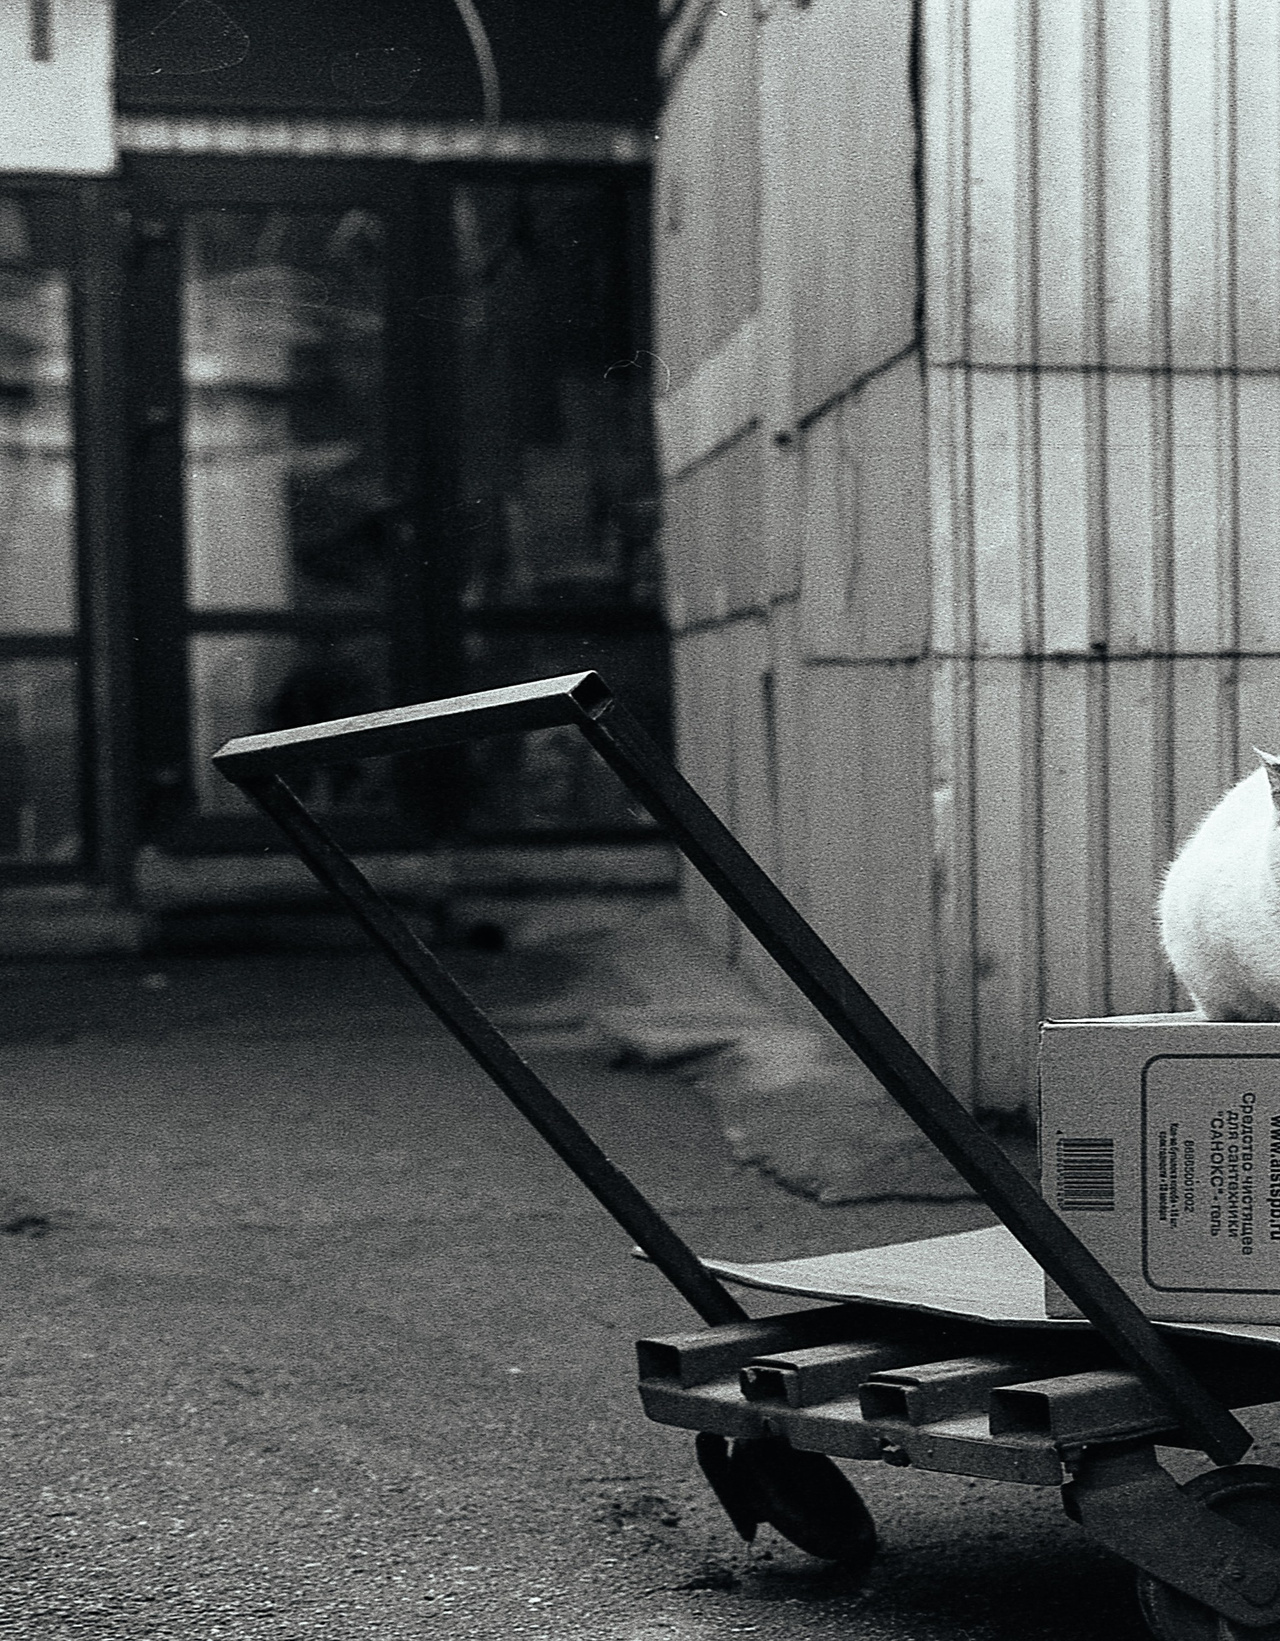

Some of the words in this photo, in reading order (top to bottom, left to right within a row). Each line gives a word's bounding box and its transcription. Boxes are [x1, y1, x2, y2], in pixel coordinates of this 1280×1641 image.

[1210, 1111, 1223, 1194] "САНОКС"
[1227, 1111, 1238, 1140] для
[1240, 1092, 1256, 1171] Средство
[1211, 1206, 1221, 1236] гель
[1228, 1145, 1238, 1237] сантехники
[1241, 1176, 1253, 1255] чистящее
